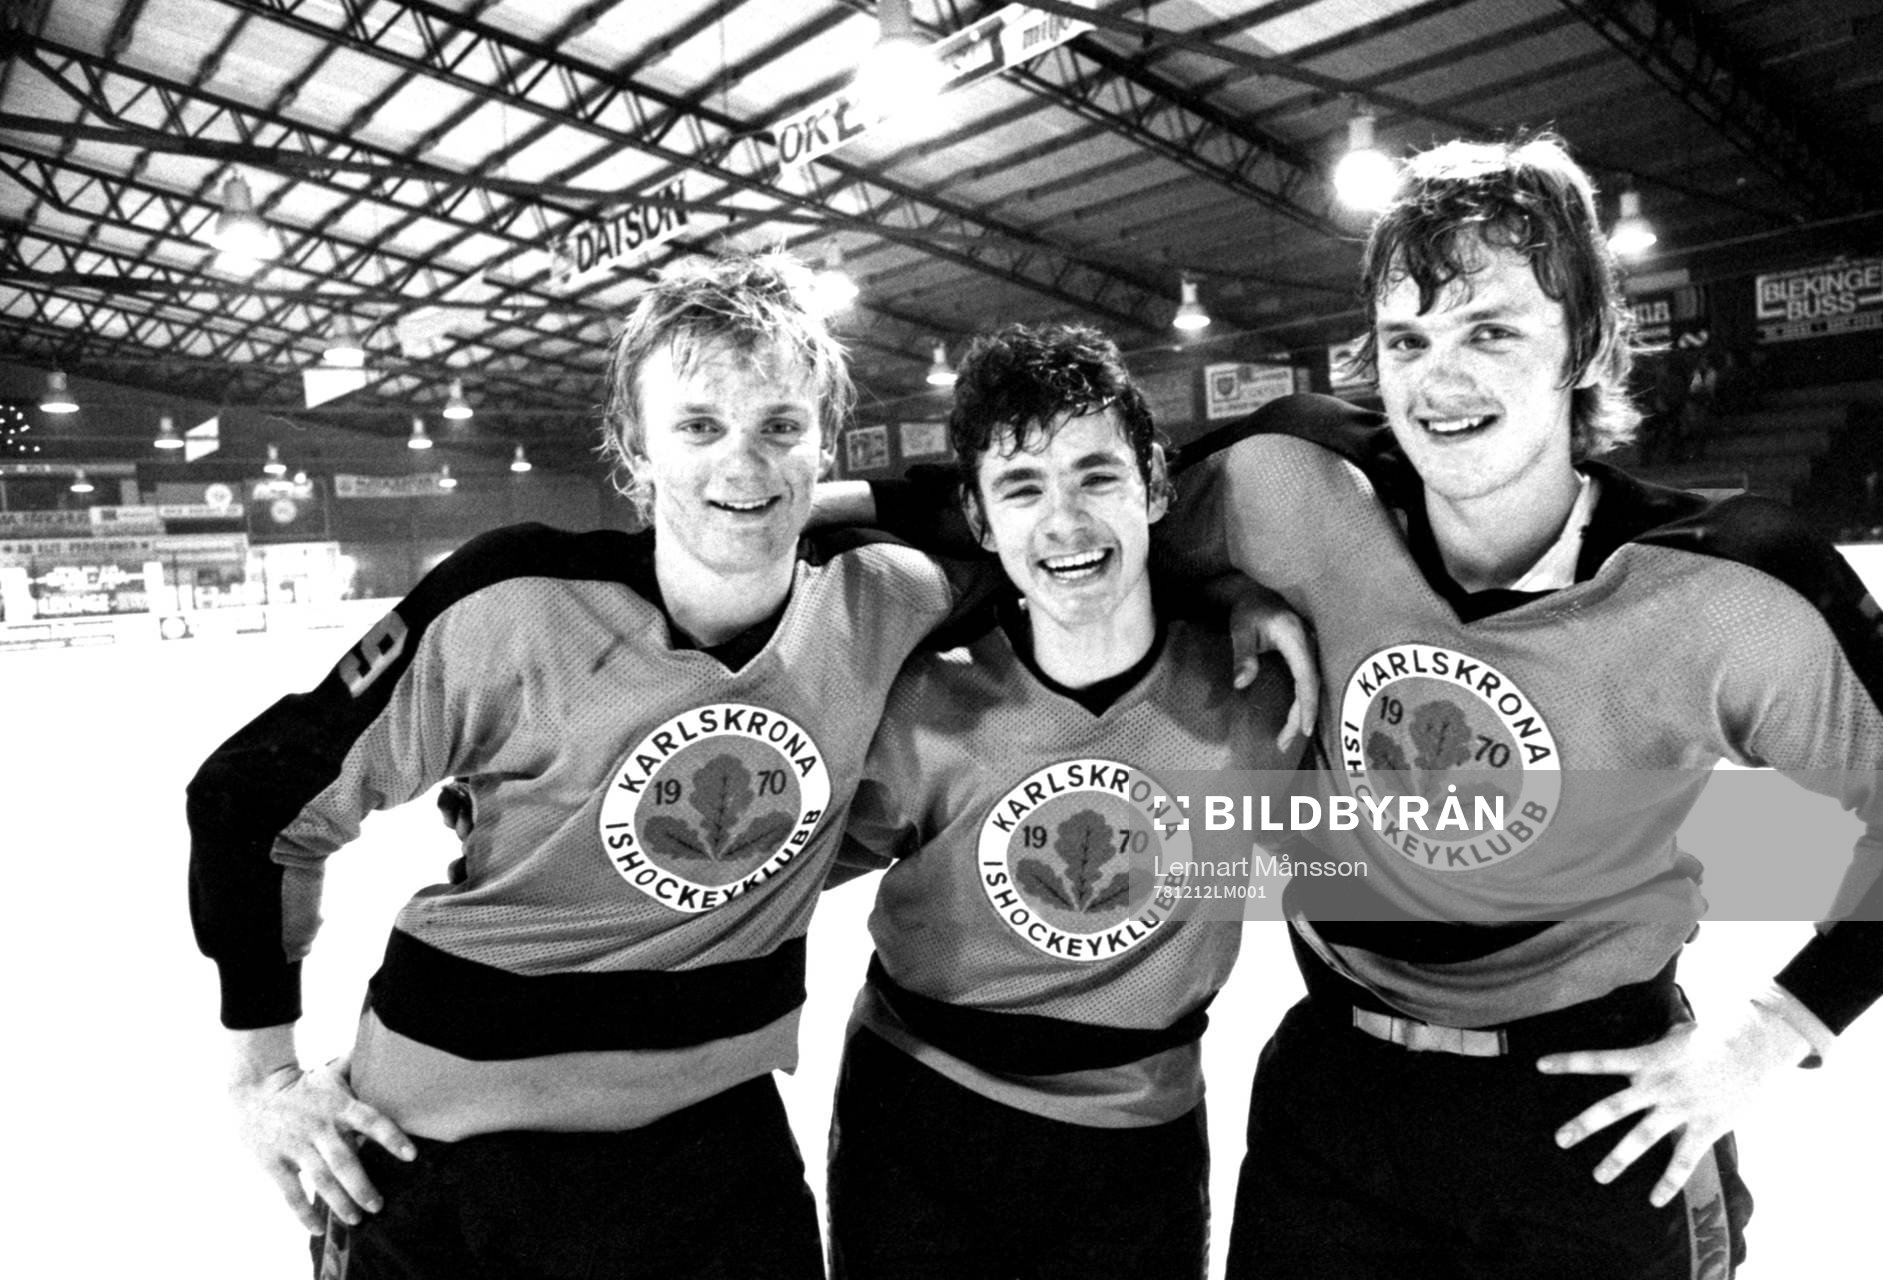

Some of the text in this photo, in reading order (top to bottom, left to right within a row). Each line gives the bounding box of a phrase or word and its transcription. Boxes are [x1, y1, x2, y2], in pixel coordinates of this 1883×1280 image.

[1764, 266, 1881, 302] BLEKINGE
[1787, 292, 1856, 320] BUSS
[1357, 649, 1551, 764] KARLSKRONA
[1380, 696, 1510, 768] 19 70
[618, 708, 817, 793] KARLSKRONA
[654, 769, 786, 805] 19 70
[992, 764, 1180, 841] KARLSKRONA
[1344, 721, 1548, 867] ISHOKEYKLUBB
[605, 809, 821, 909] ISHOCKEYKLUBB
[1023, 825, 1149, 854] 19 70
[983, 861, 1185, 956] ISHOCKEYKLUBB
